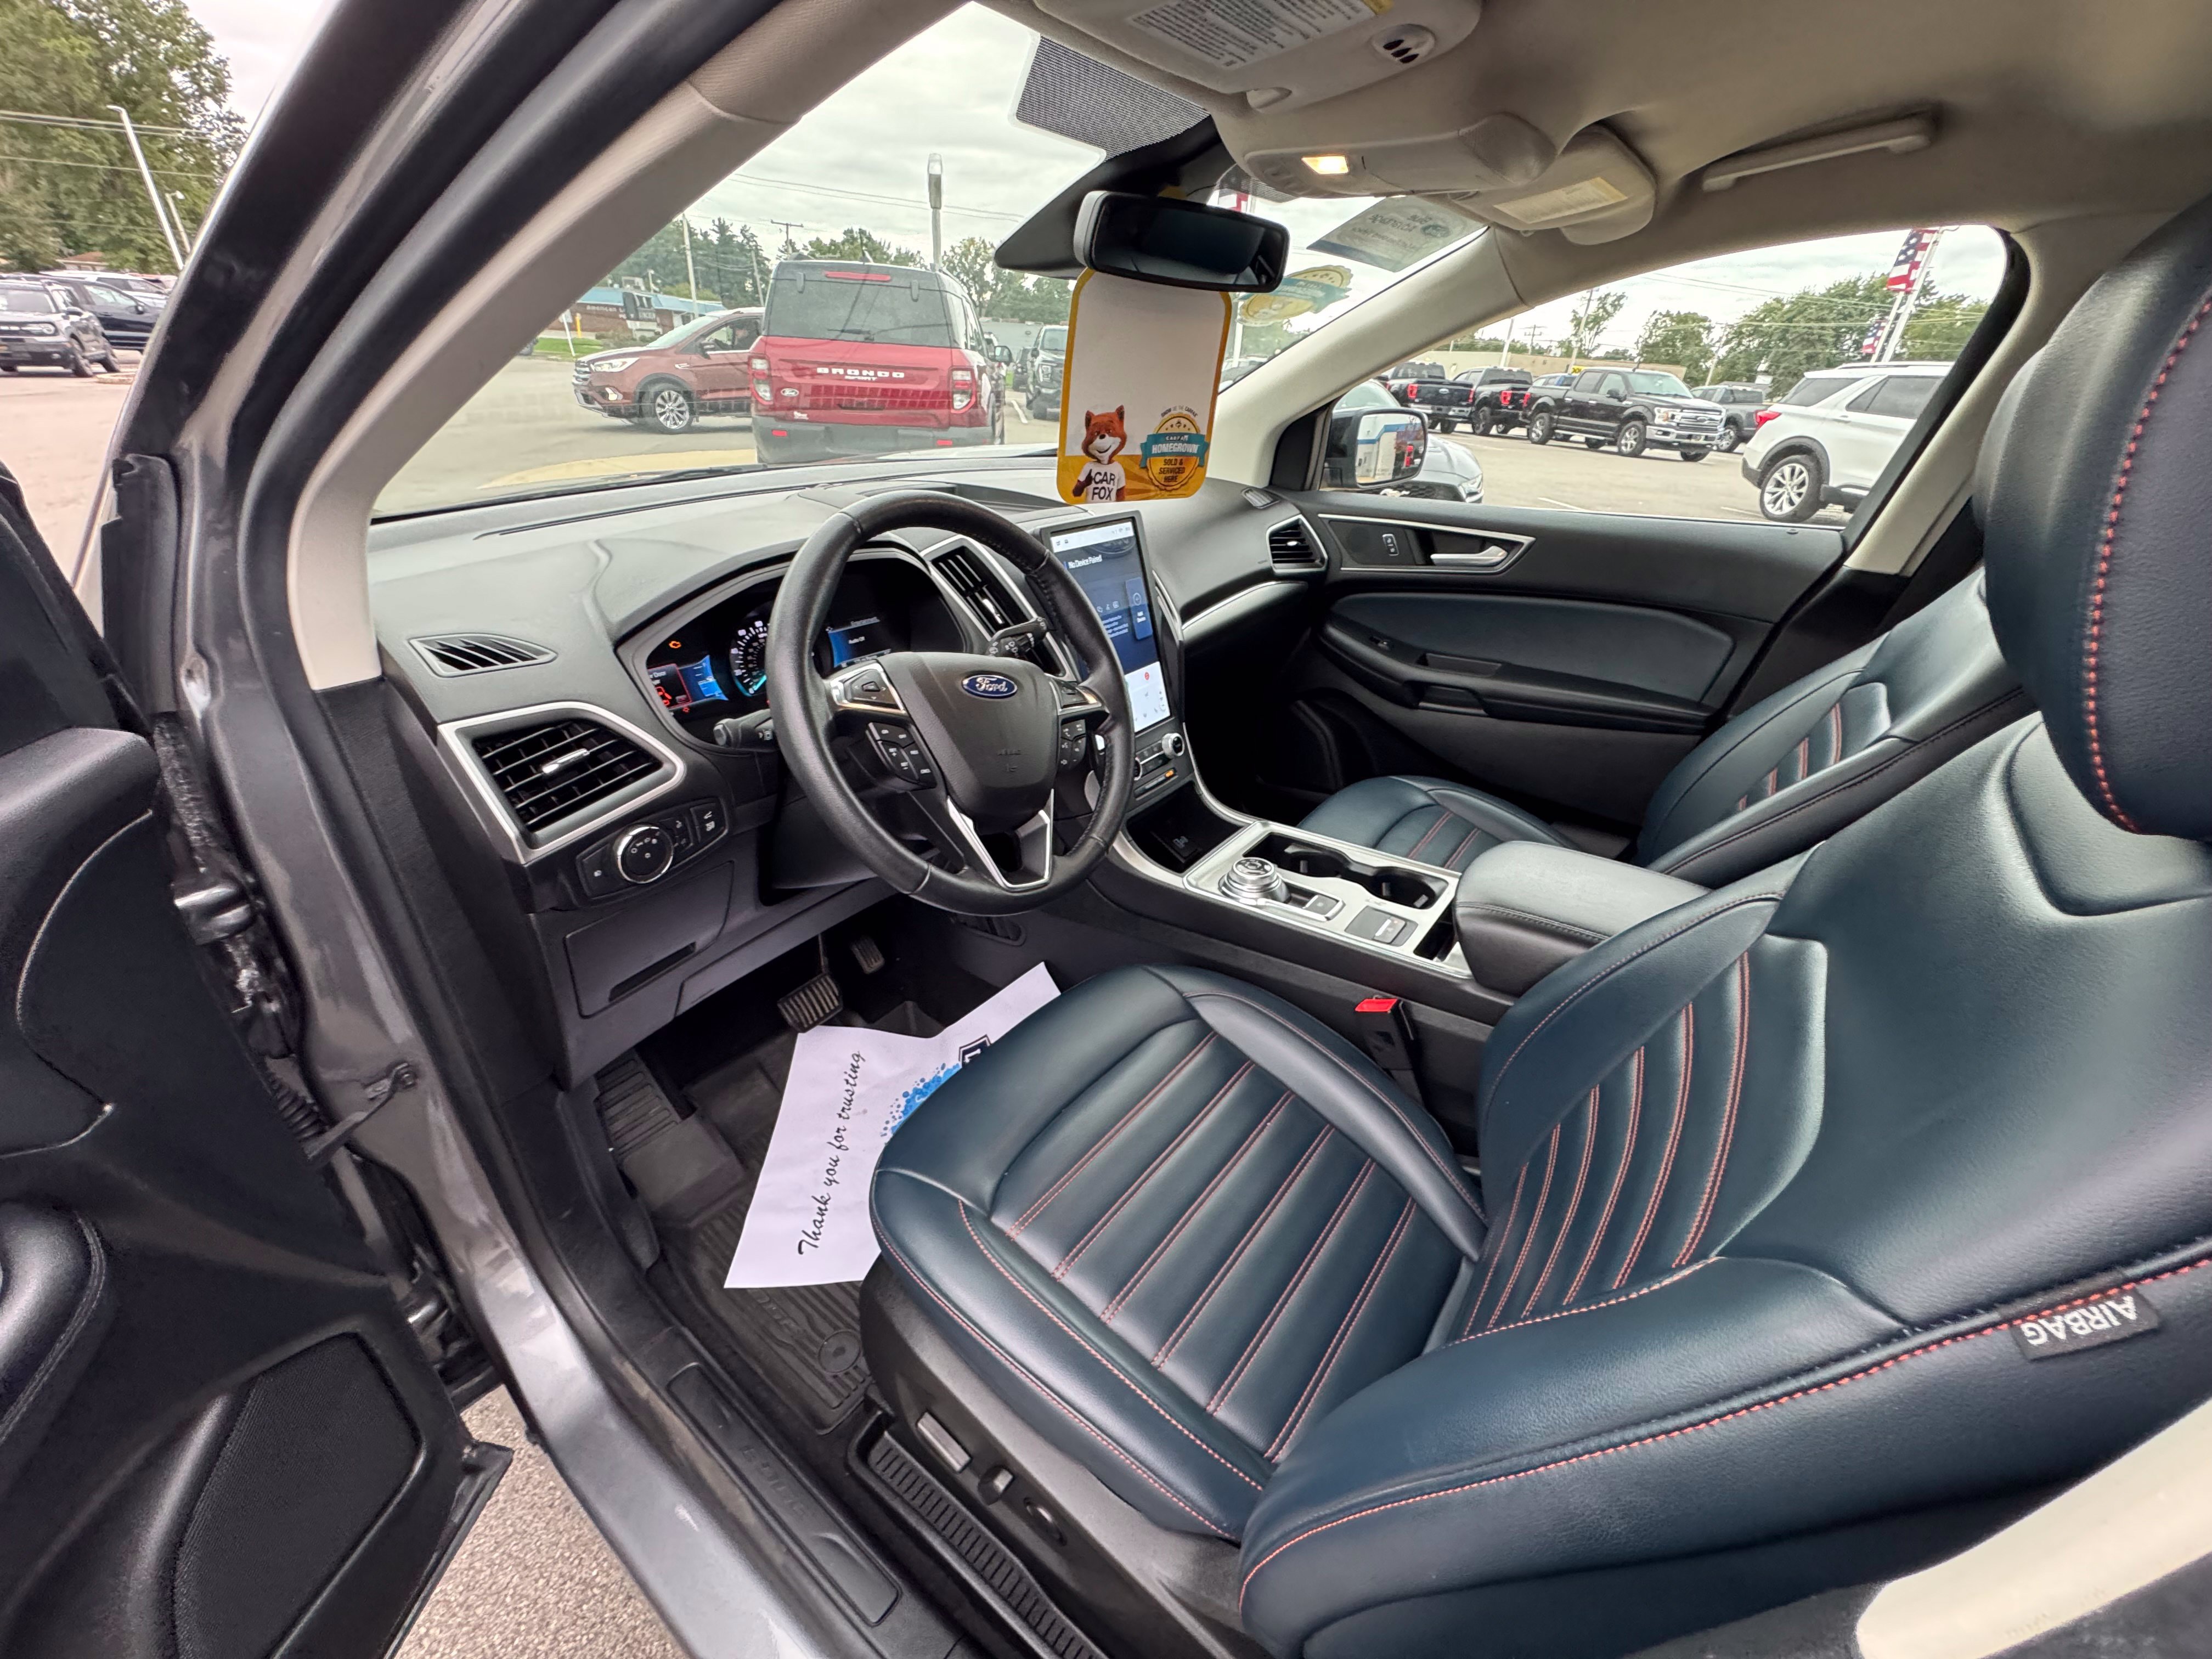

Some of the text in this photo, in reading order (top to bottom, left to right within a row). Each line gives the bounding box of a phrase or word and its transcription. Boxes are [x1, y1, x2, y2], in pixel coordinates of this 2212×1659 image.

[816, 367, 905, 378] BRONCO
[1152, 443, 1199, 454] HOMEGROWN
[1093, 472, 1116, 486] CAR
[1092, 486, 1114, 500] FOX
[973, 676, 1011, 693] Ford
[798, 1050, 867, 1256] Thank you for trusting
[2020, 1295, 2138, 1346] AIRBAG
